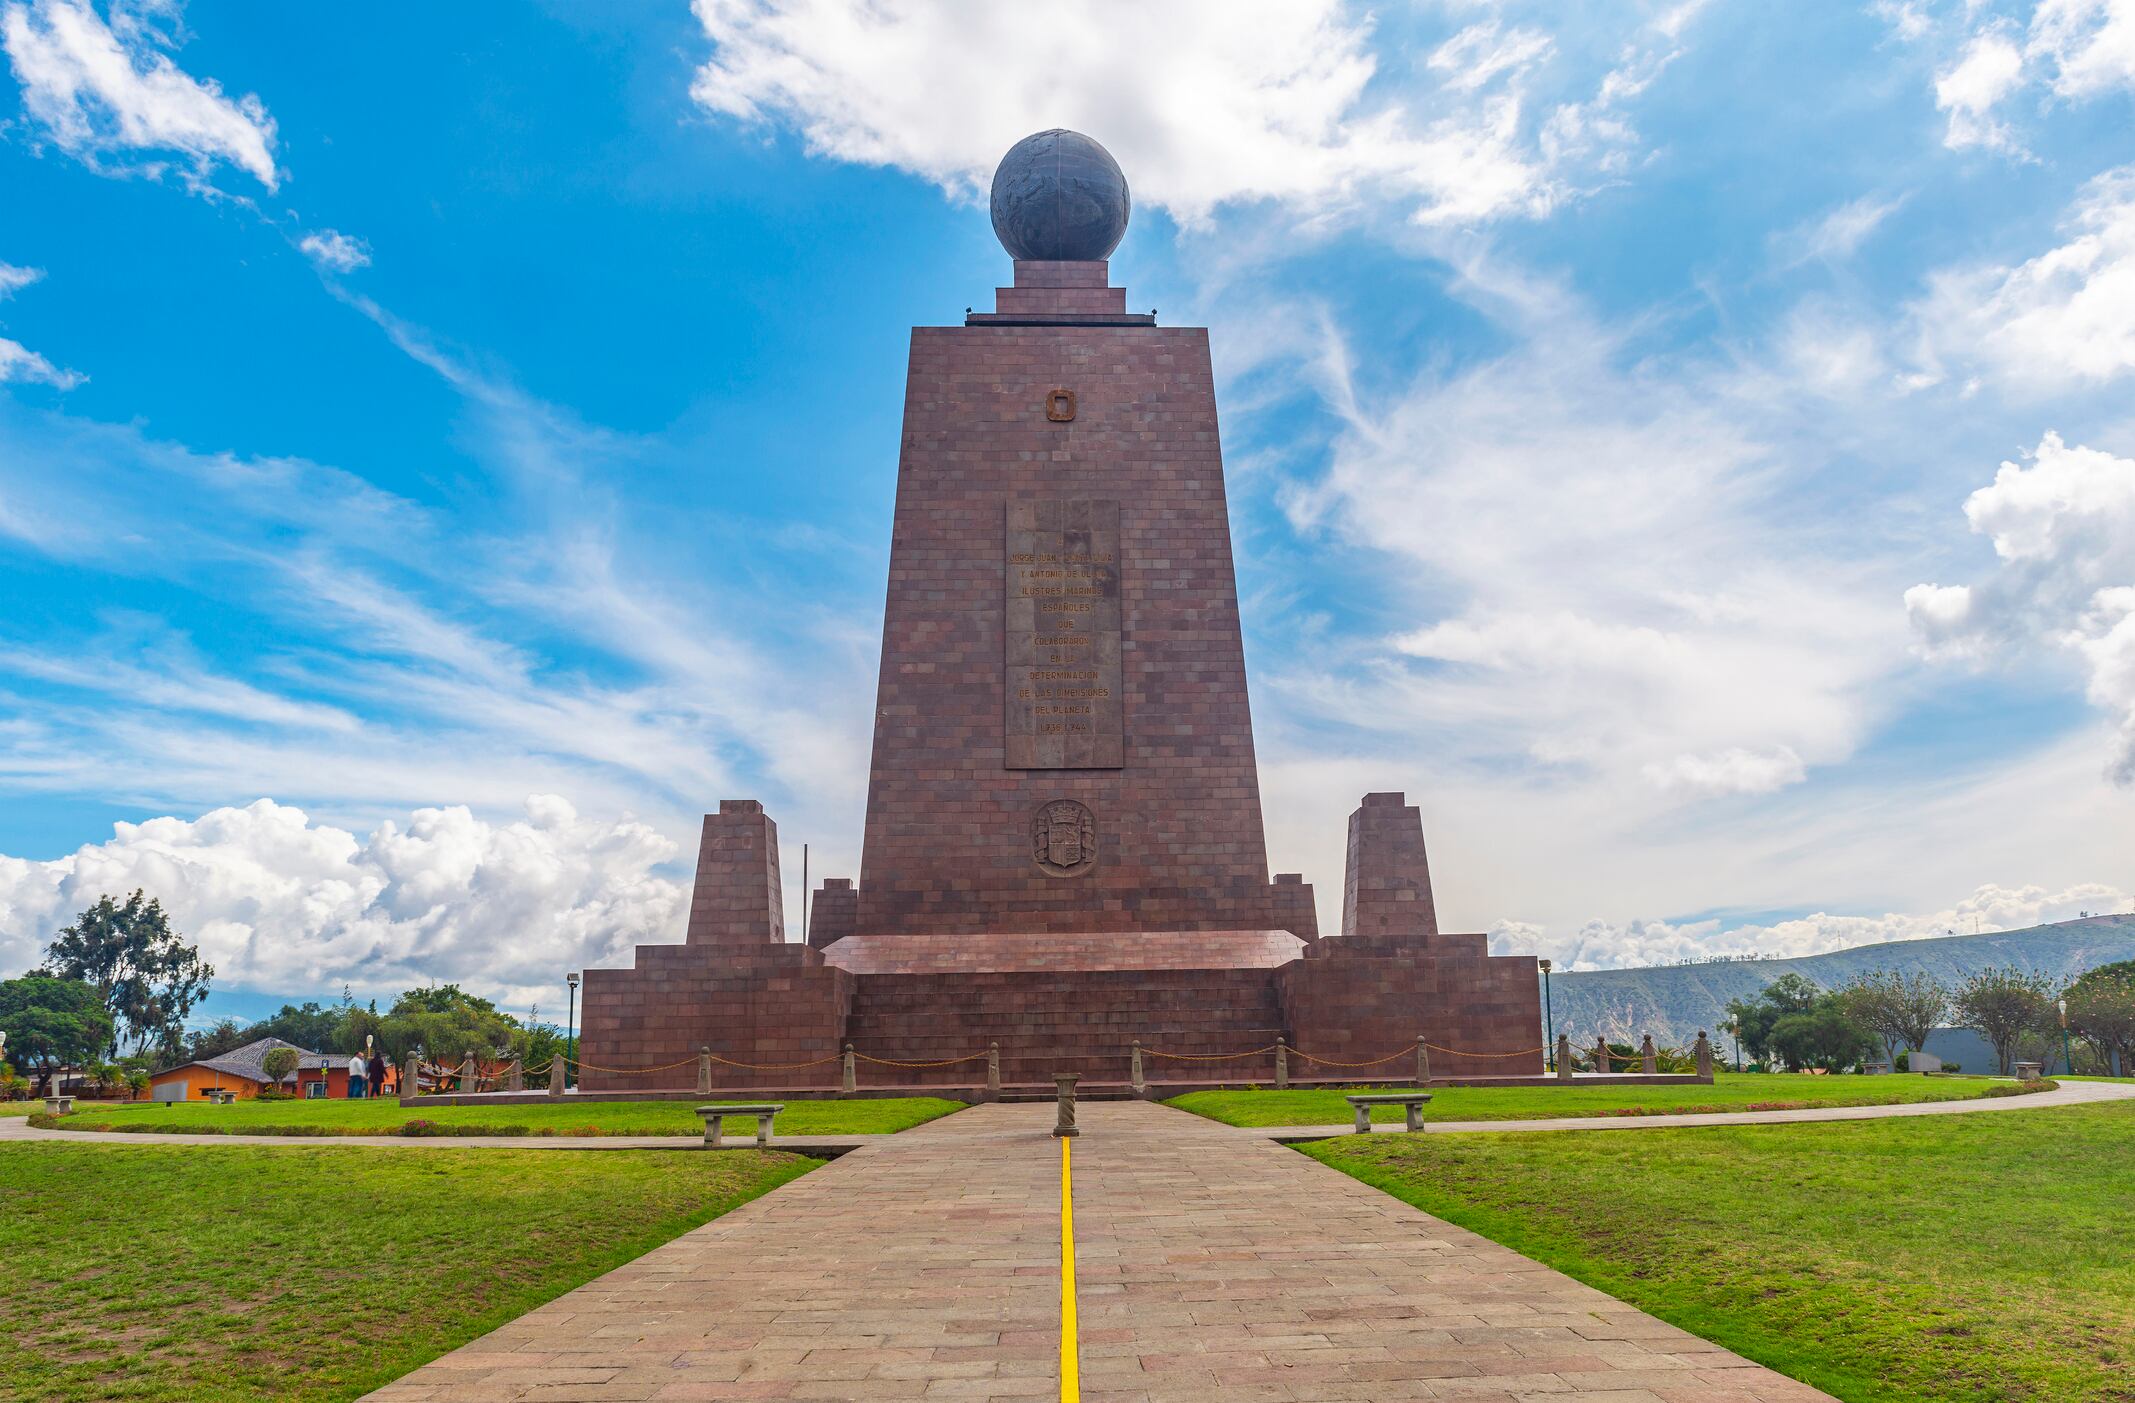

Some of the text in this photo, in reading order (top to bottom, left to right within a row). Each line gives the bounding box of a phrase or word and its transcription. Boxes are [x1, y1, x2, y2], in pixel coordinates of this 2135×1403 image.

[1009, 554, 1034, 562] JORGE
[1038, 554, 1057, 562] JUAN
[1022, 587, 1102, 595] ILUSTRES MARINOS
[1042, 602, 1090, 612] ESPAÑOLES
[1057, 621, 1074, 629] QUE
[1034, 637, 1089, 645] COLABORARON
[1056, 689, 1109, 697] DIMENSIONES
[1035, 706, 1090, 714] DEL PLANETA
